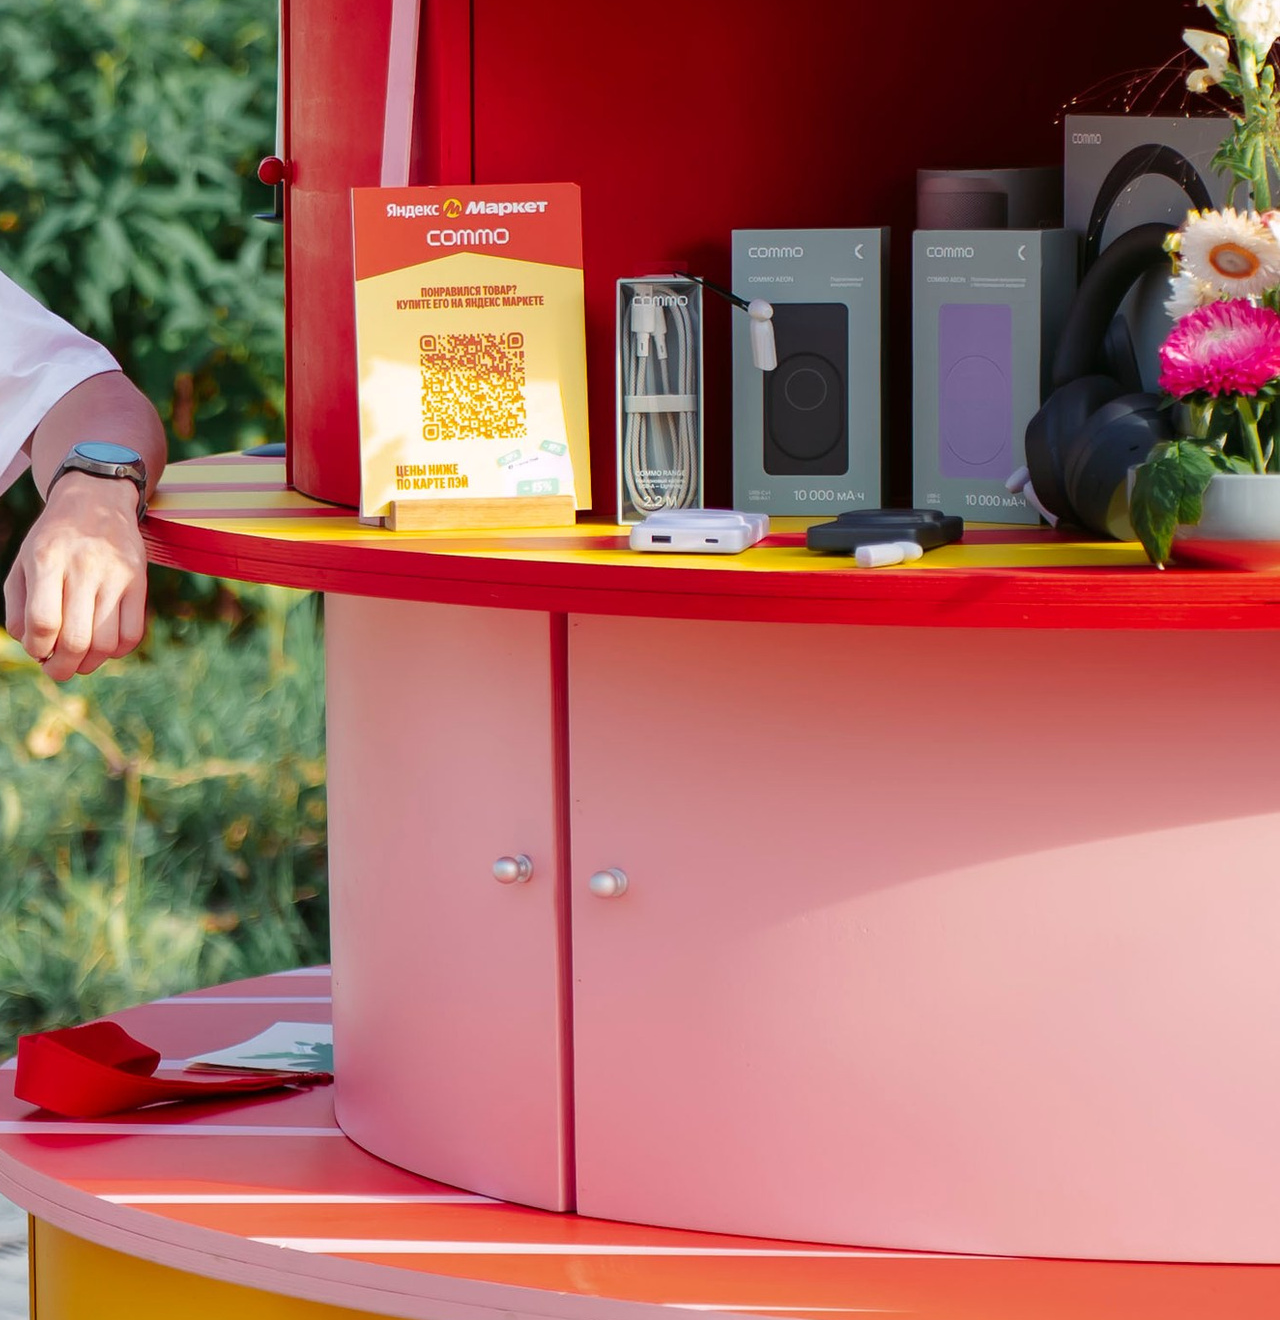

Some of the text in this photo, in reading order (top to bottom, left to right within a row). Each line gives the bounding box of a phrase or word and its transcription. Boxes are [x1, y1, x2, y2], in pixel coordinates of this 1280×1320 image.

[386, 201, 549, 219] Яндекс Маркет
[420, 284, 518, 298] ПОНРАВИЛСЯ ТОВАР?
[396, 295, 544, 310] КУПИТЕ ЕГО НА ЯНДЕКС МАРКЕТЕ
[396, 463, 459, 478] ЦЕНЫ НИЖЕ
[396, 474, 469, 491] ПО КАРТЕ ПЭЙ
[793, 489, 807, 502] 10
[808, 489, 835, 502] 000
[965, 494, 977, 506] 10
[978, 494, 1001, 507] 000
